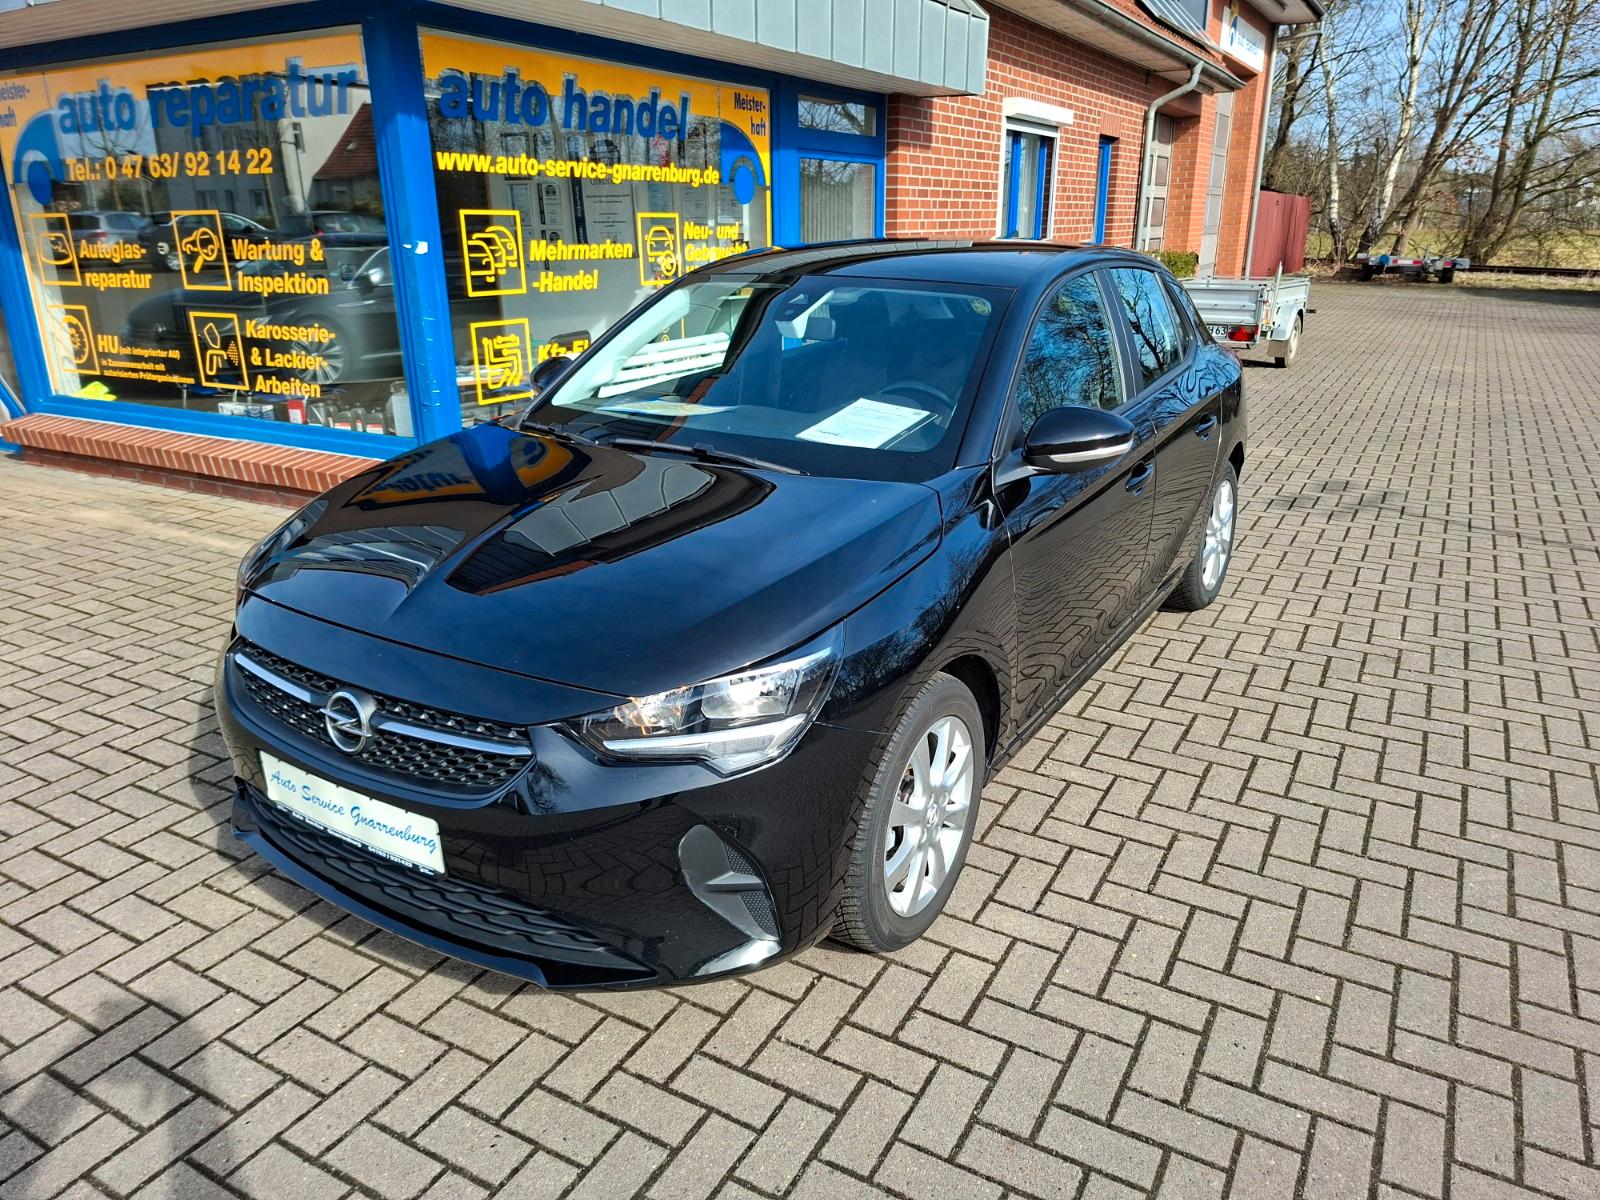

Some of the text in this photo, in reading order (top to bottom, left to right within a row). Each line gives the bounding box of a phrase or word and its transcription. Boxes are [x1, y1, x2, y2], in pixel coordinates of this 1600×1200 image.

[0, 82, 30, 101] eister-
[58, 63, 359, 138] auto reparatur
[734, 92, 766, 114] Meister-
[439, 73, 689, 141] auto handel
[750, 116, 766, 136] haft
[66, 147, 273, 182] Tel.: 0 47 63/ 92 14 22
[436, 150, 720, 188] www.auto-service-gnarrenburg.de
[684, 221, 740, 240] Neu- und
[79, 240, 147, 260] Autoglas-
[232, 239, 324, 265] Wartung &
[529, 239, 633, 261] Mehrmarken
[85, 271, 152, 291] reparatur
[238, 271, 329, 296] Inspektion
[532, 270, 598, 293] -Handel
[246, 320, 336, 341] Karosserie-
[1215, 326, 1226, 335] 63
[97, 334, 119, 353] HU
[537, 339, 589, 364] Kfz-El
[251, 348, 328, 371] & Lackier-
[255, 375, 321, 398] Arbeiten
[271, 770, 297, 793] Auto
[301, 785, 345, 816] Service
[351, 806, 437, 855] Gnarrenburg
